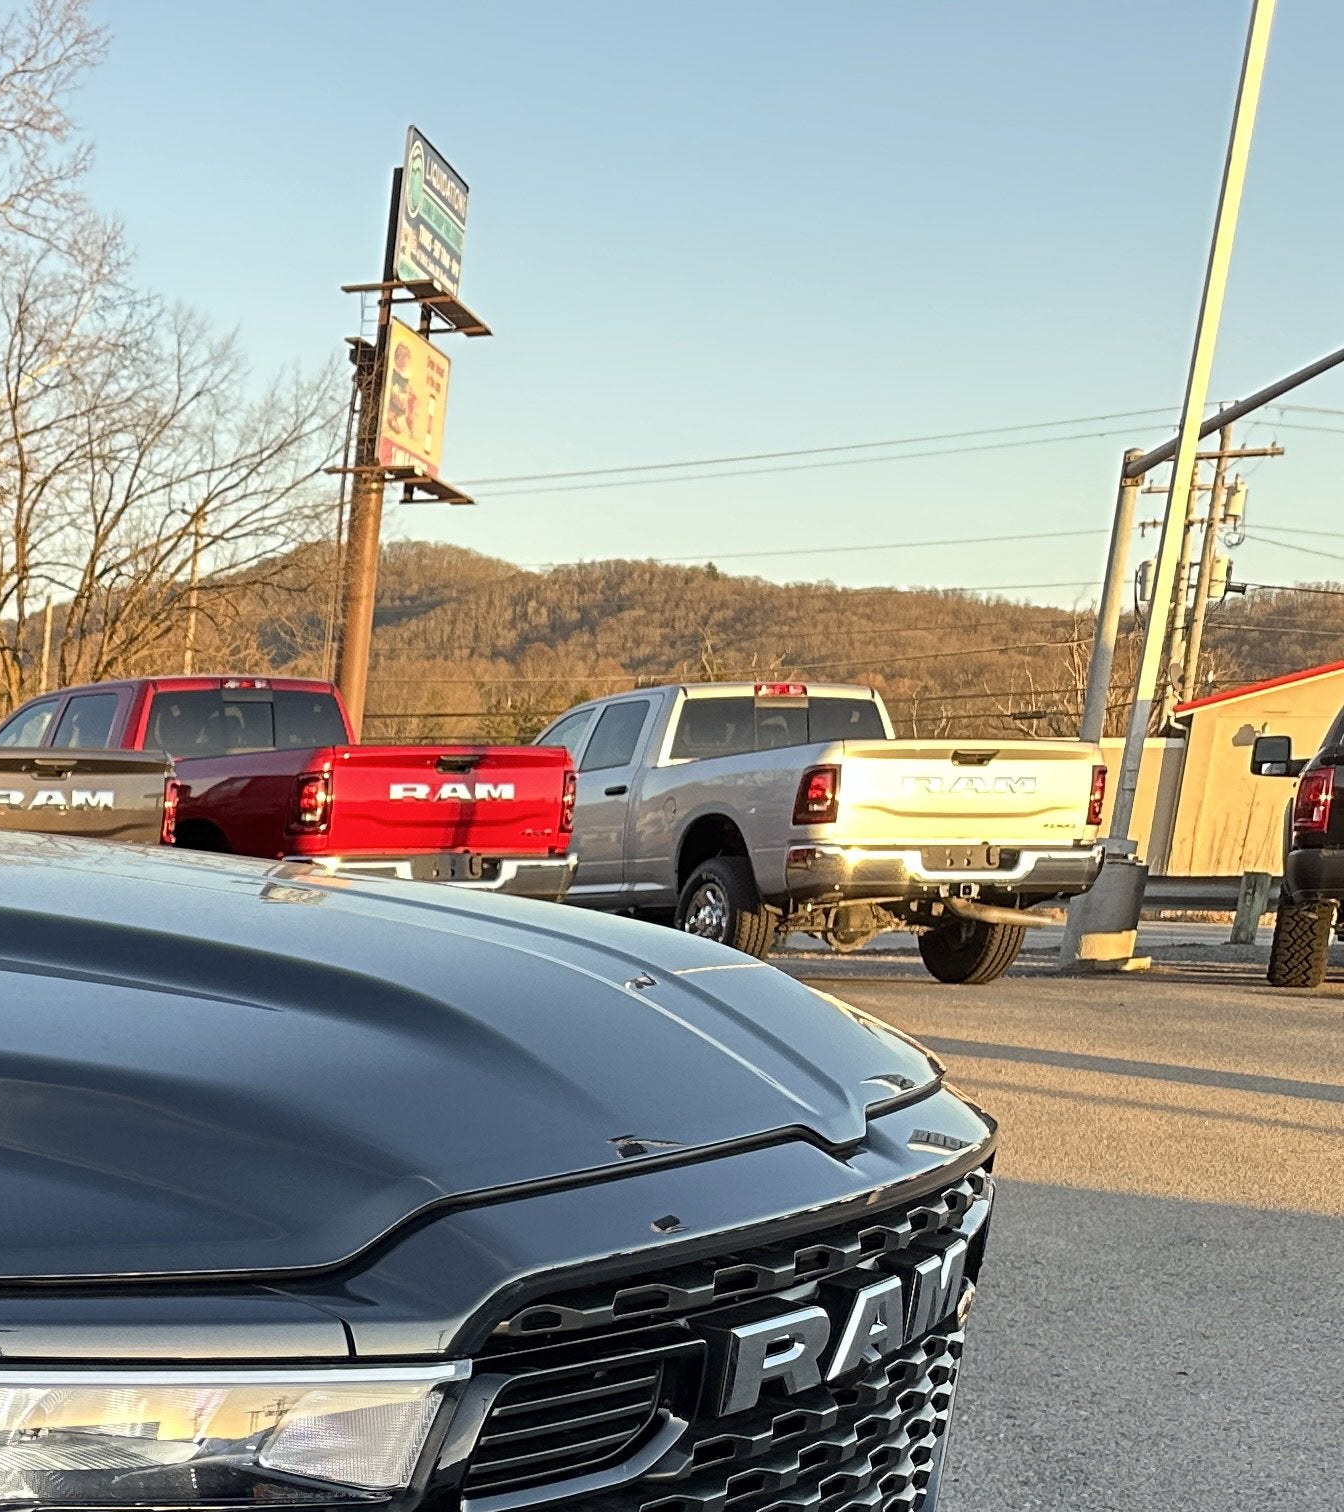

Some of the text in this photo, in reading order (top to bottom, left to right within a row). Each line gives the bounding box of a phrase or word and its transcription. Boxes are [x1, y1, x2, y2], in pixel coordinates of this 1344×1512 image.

[389, 783, 515, 803] RAM
[902, 776, 1036, 794] RAM
[718, 1237, 968, 1418] RAM
